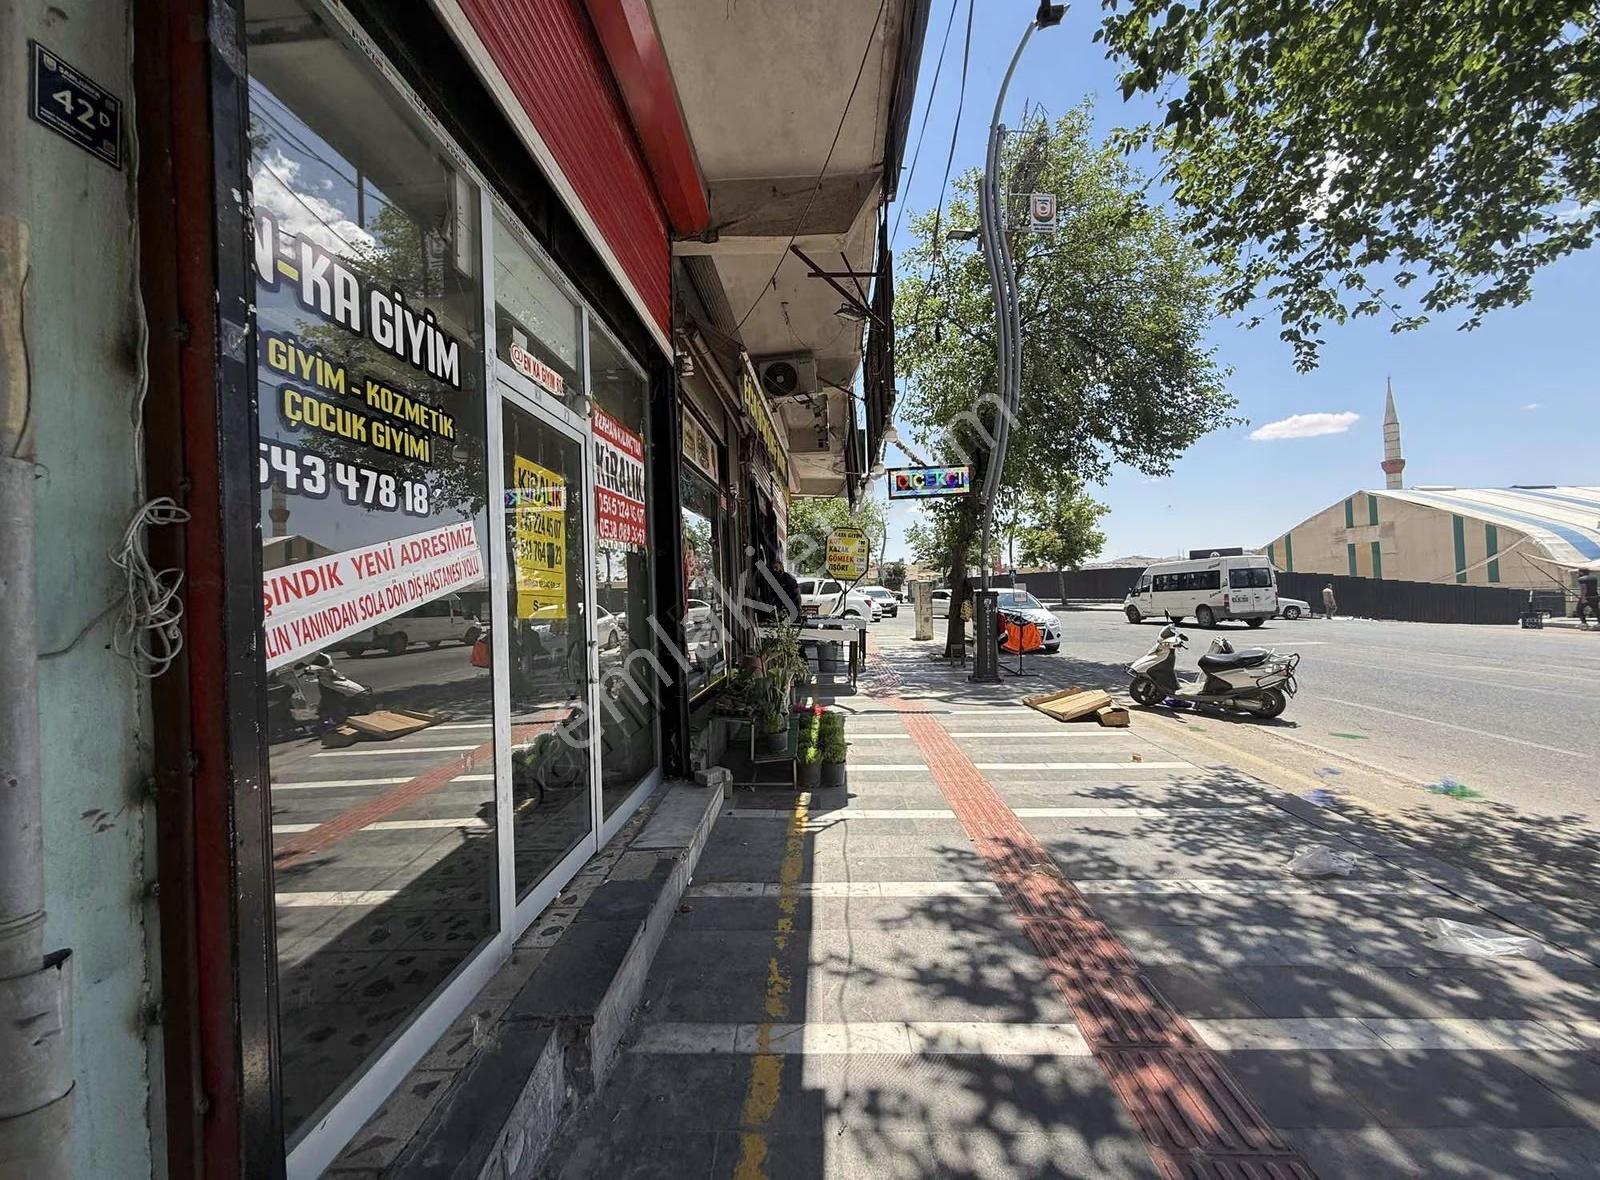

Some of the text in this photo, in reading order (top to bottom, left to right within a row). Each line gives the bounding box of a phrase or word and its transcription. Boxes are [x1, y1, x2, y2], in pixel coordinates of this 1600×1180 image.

[371, 289, 460, 387] GİYİM
[268, 337, 345, 395] GİYİM
[366, 380, 455, 440] KOZMETİK
[284, 389, 430, 463] ÇOCUK GİYİMİ
[335, 462, 397, 509] 478
[596, 441, 645, 503] KİRALIK
[351, 541, 396, 580] YENİ
[400, 523, 475, 567] ADRESİMİZ
[828, 553, 854, 562] GÖMLEK
[291, 600, 359, 647] YANINDAN
[359, 589, 386, 621] SOLA
[386, 579, 407, 609] DÖN
[409, 572, 424, 601] DİŞ
[424, 556, 462, 592] HASTANESİ
[463, 556, 480, 577] YOLU
